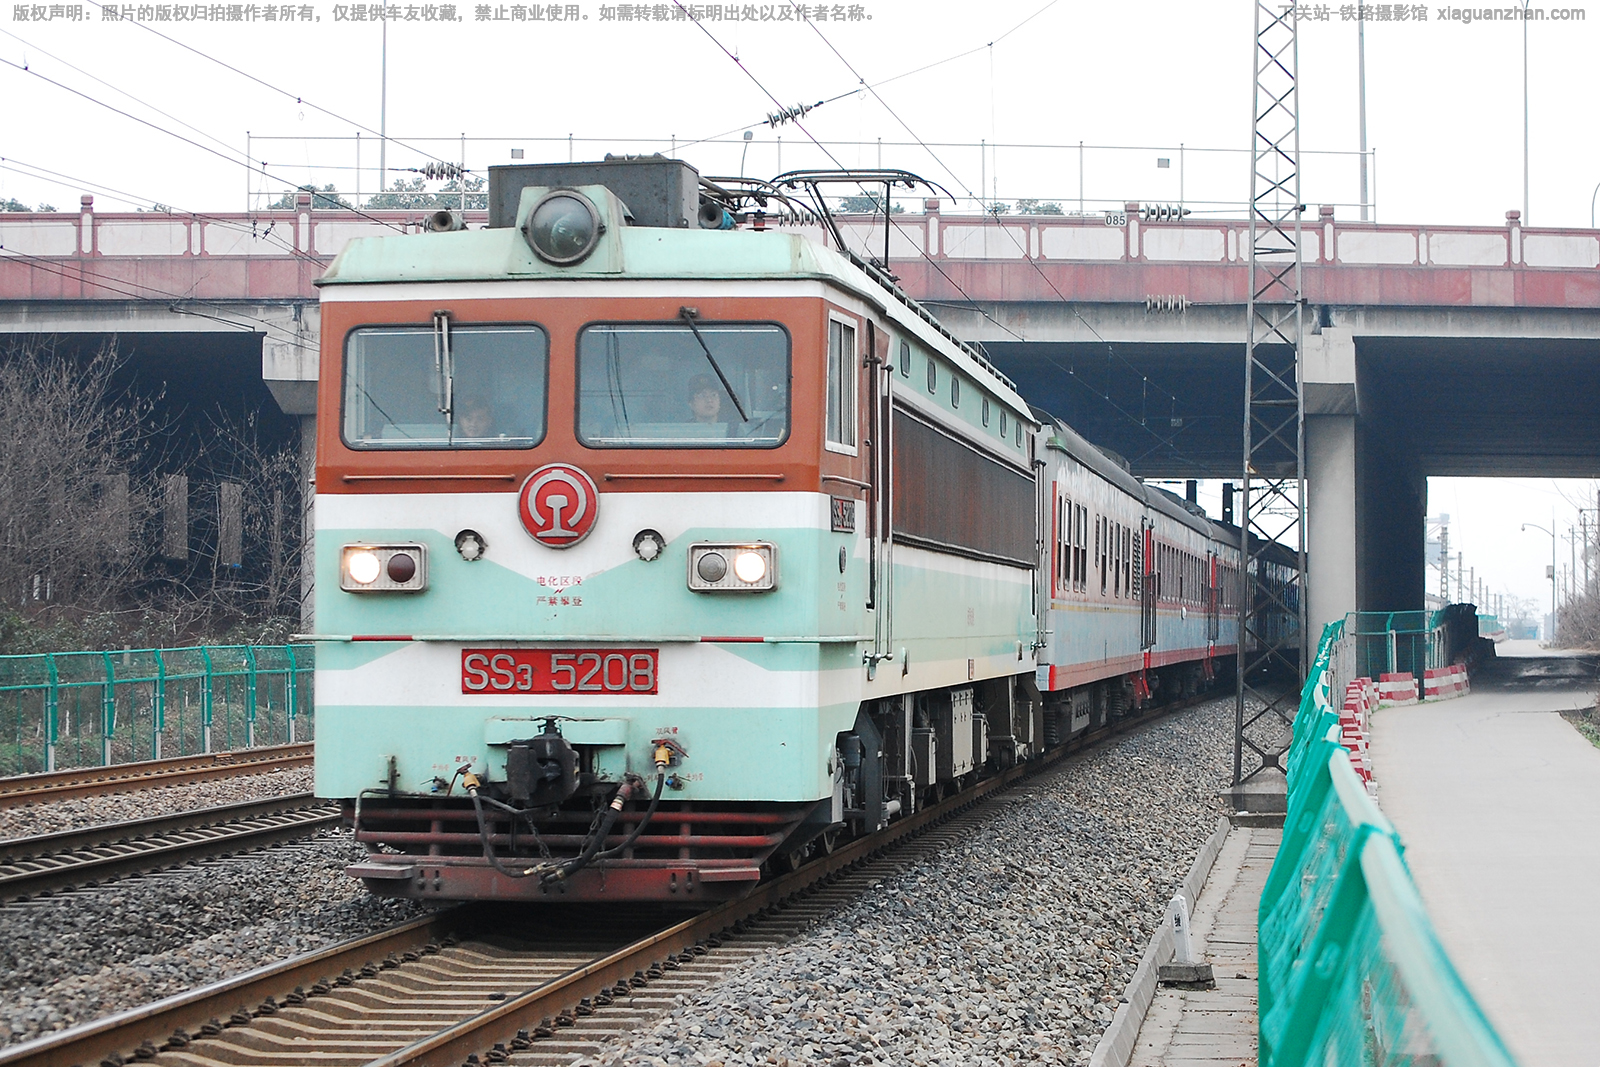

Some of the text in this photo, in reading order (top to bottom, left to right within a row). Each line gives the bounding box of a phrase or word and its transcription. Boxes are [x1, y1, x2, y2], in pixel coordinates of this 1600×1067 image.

[1105, 215, 1125, 225] 085
[536, 576, 582, 586] 电化区段
[464, 653, 654, 691] SS3 5208
